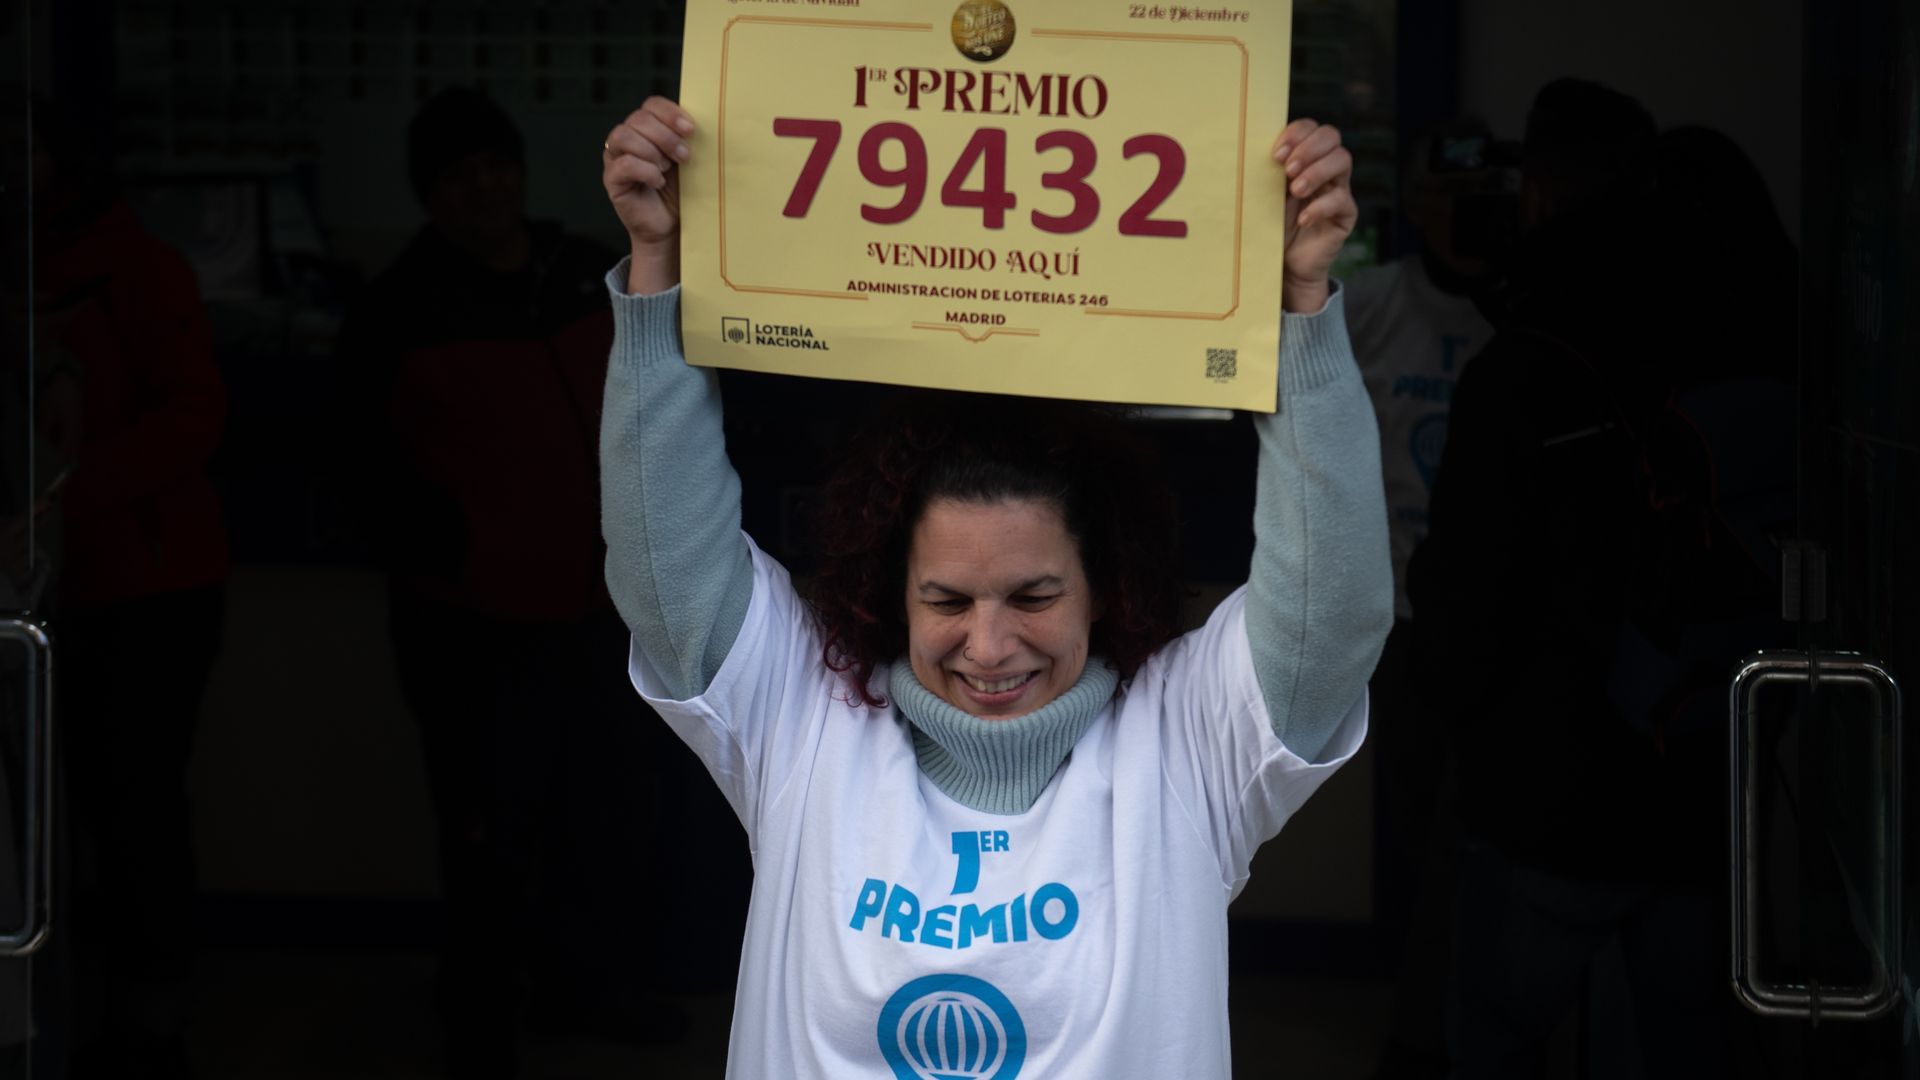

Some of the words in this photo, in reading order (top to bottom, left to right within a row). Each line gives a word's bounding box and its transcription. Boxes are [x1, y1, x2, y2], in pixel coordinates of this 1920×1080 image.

[1129, 4, 1146, 18] 22
[1149, 6, 1165, 19] de
[1169, 6, 1250, 22] Diciembre
[894, 67, 1108, 119] PREMIO
[773, 117, 1188, 238] 79432
[868, 242, 997, 272] VENDIDO
[1006, 247, 1081, 280] AQUÍ
[847, 280, 977, 301] ADMINISTRACION
[981, 288, 1001, 301] DE
[1004, 290, 1076, 306] LOTERIAS
[1079, 294, 1109, 308] 246
[755, 324, 814, 338] LOTERÍA
[945, 311, 1006, 326] MADRID
[756, 336, 830, 351] NACIONAL
[950, 830, 1010, 896] 1ER
[849, 877, 1080, 950] PREMIO
